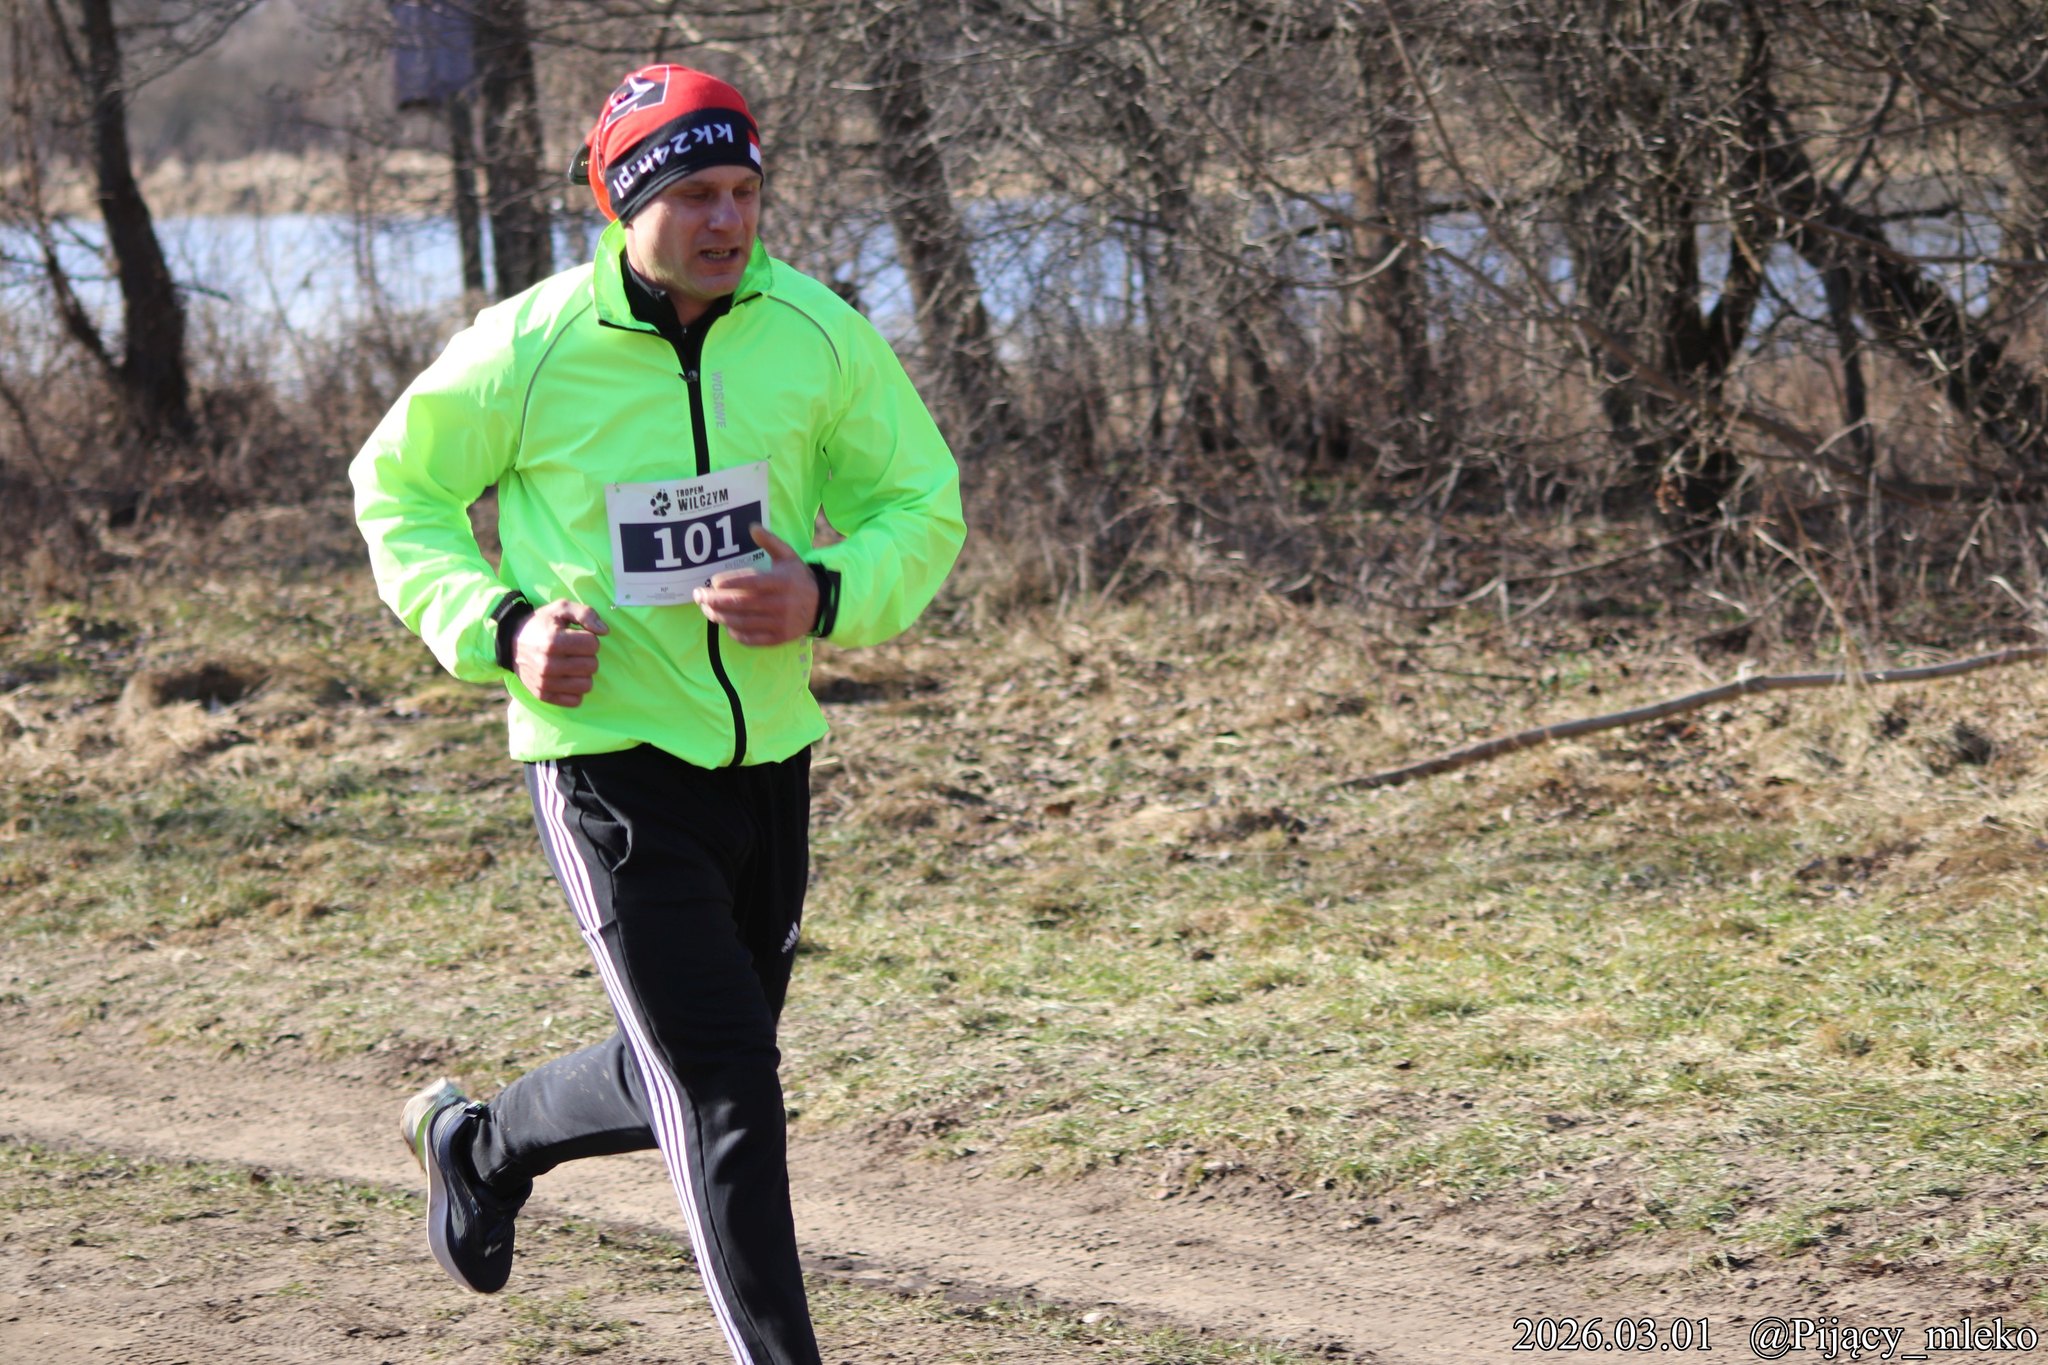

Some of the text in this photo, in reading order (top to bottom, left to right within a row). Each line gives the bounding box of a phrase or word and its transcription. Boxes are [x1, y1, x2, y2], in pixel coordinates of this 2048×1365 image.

[613, 123, 734, 199] kk24h.pl
[712, 370, 727, 429] WOSAWE
[676, 485, 704, 498] TROPEM
[678, 488, 729, 511] WILCZYM
[653, 514, 740, 569] 101
